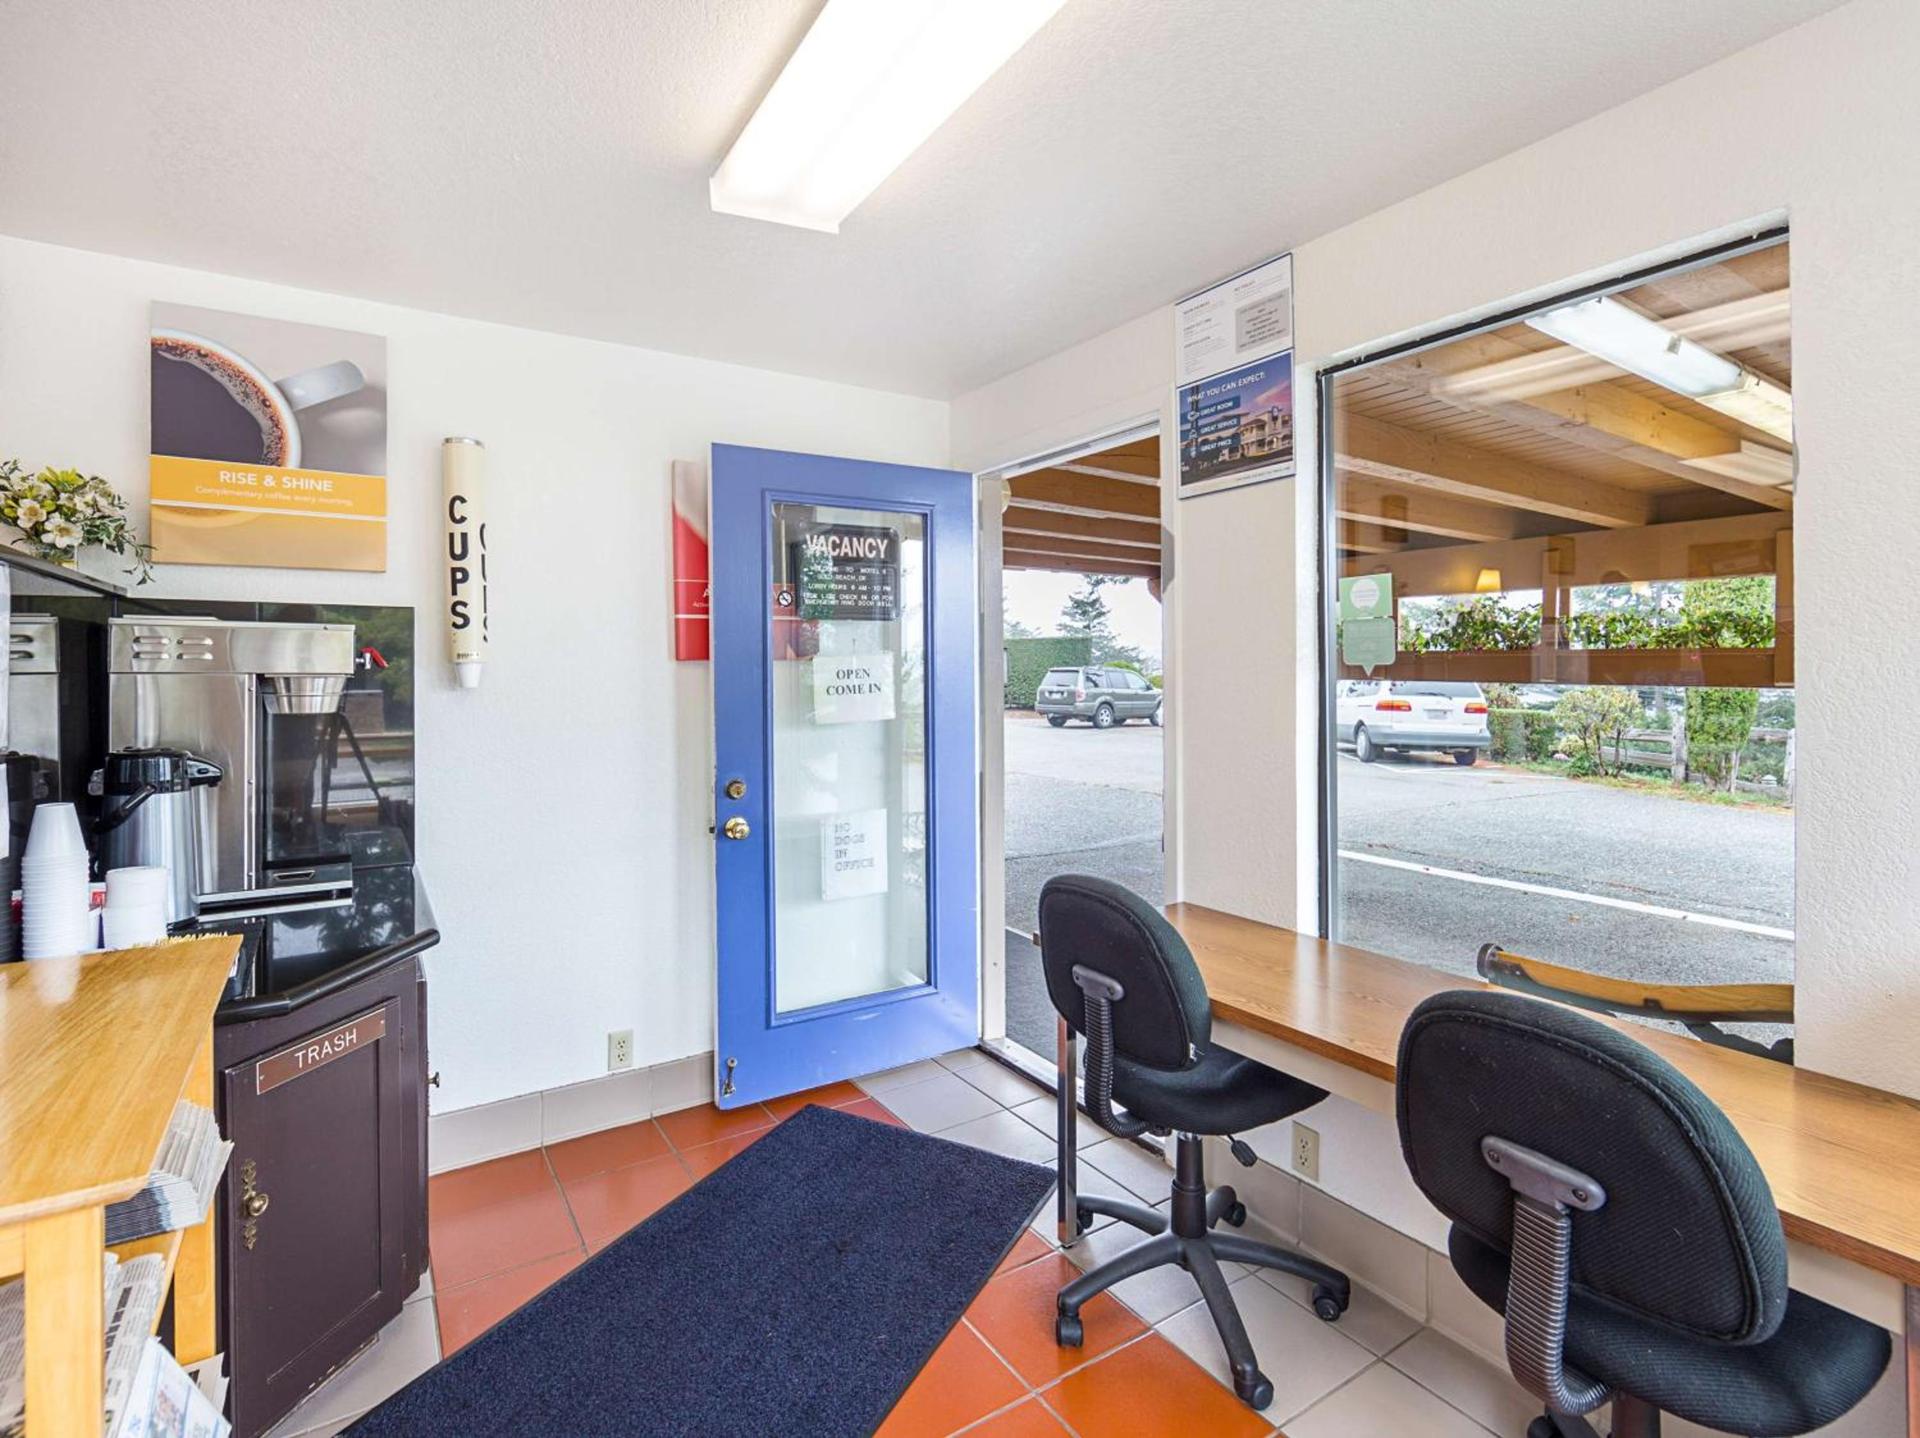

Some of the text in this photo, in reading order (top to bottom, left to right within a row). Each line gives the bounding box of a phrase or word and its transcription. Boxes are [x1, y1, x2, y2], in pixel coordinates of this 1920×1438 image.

[1206, 386, 1221, 398] YOU
[1221, 381, 1238, 392] CAN
[1200, 424, 1216, 434] GREAT
[1200, 441, 1216, 452] GREAT
[219, 470, 333, 492] RISE & SHINE
[805, 533, 888, 559] VACANCY
[448, 494, 471, 630] CUPS
[838, 593, 858, 601] CHECK
[836, 668, 871, 681] OPEN
[826, 683, 882, 697] COME IN
[294, 1028, 358, 1069] TRASH
